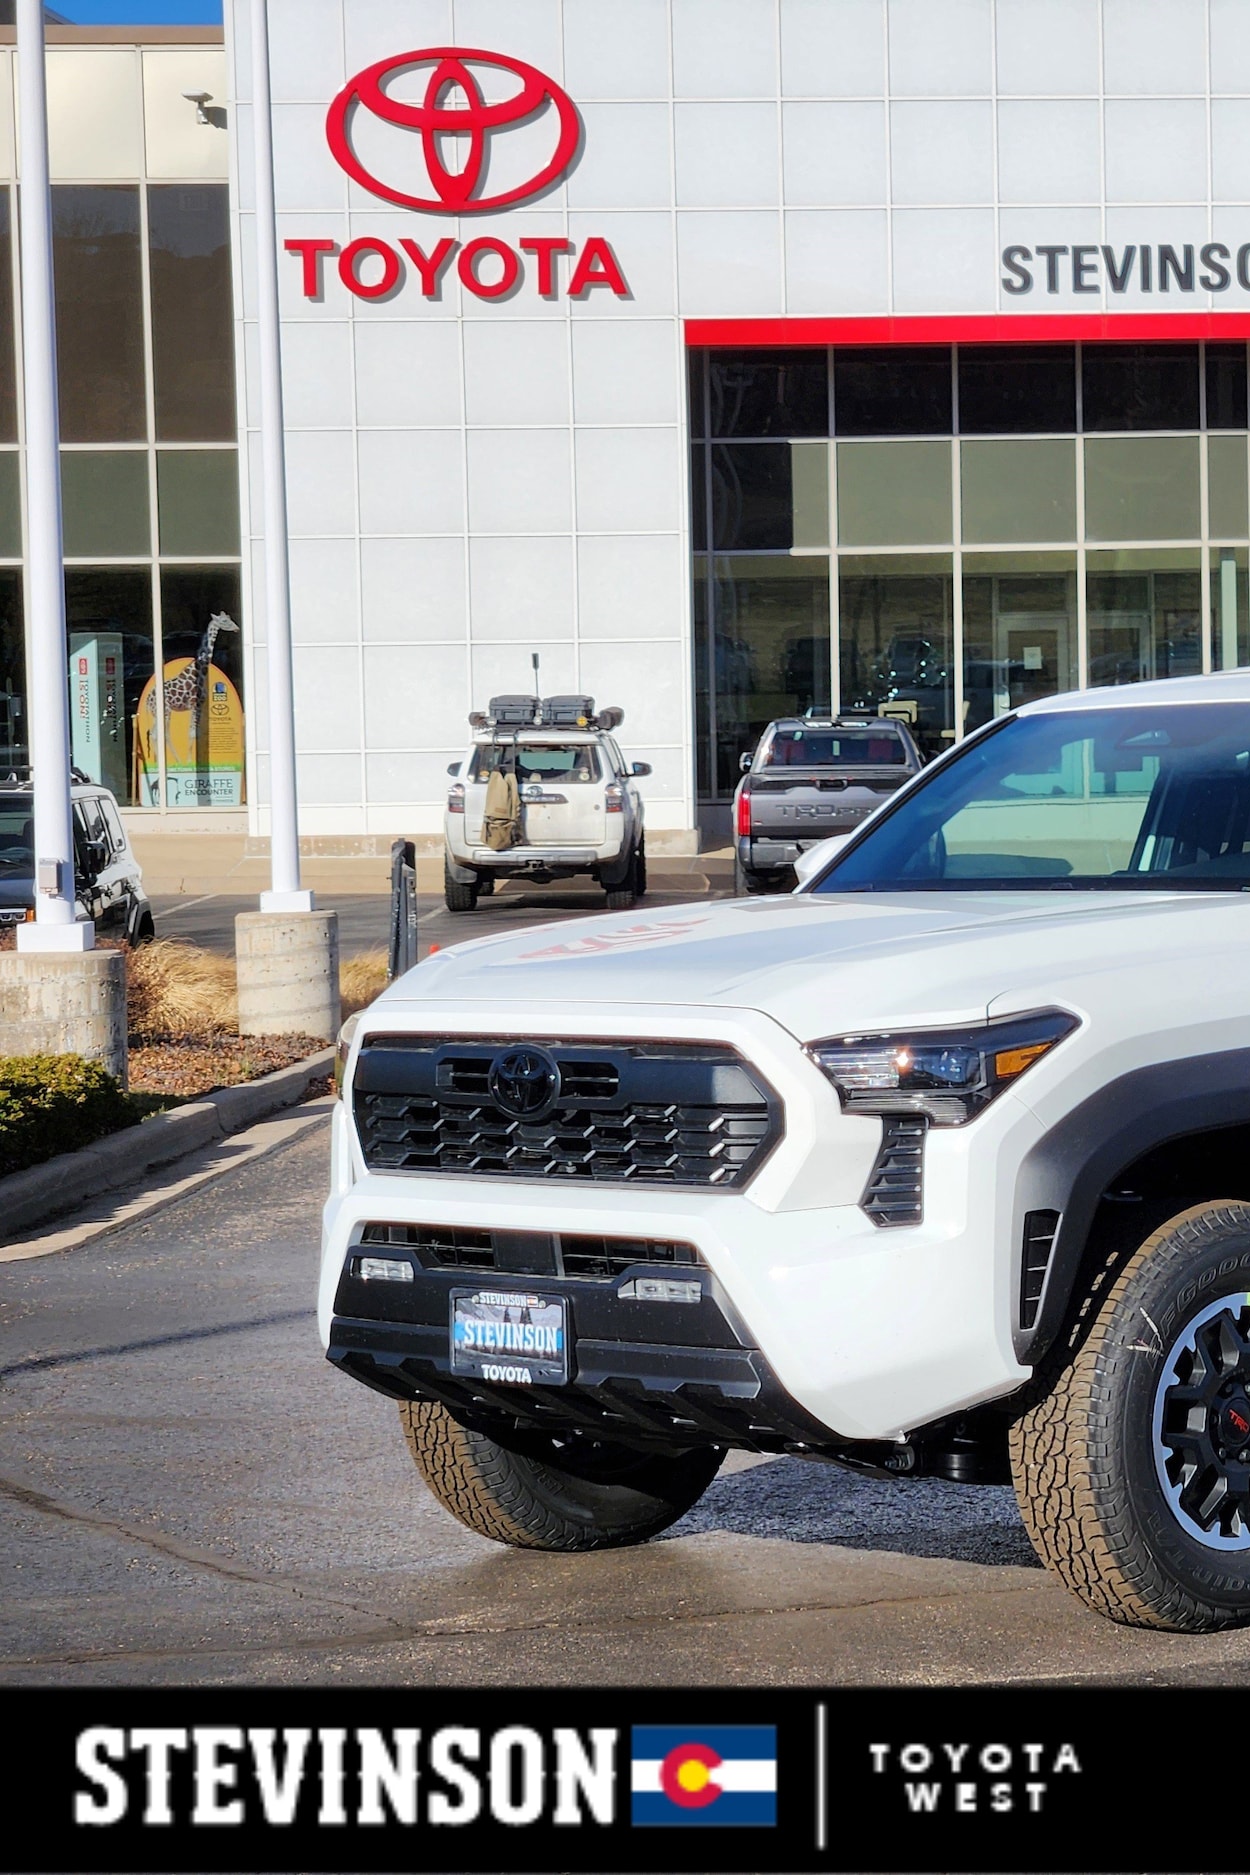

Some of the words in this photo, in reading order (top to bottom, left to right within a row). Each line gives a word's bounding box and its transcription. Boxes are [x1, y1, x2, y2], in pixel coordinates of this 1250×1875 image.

[284, 237, 629, 298] TOYOTA
[184, 779, 234, 788] GIRAFFE
[776, 804, 835, 820] TRD
[479, 1292, 527, 1307] STEVINSON
[464, 1320, 558, 1354] STEVINSON
[481, 1364, 532, 1384] TOYOTA
[1229, 1409, 1250, 1433] TRD
